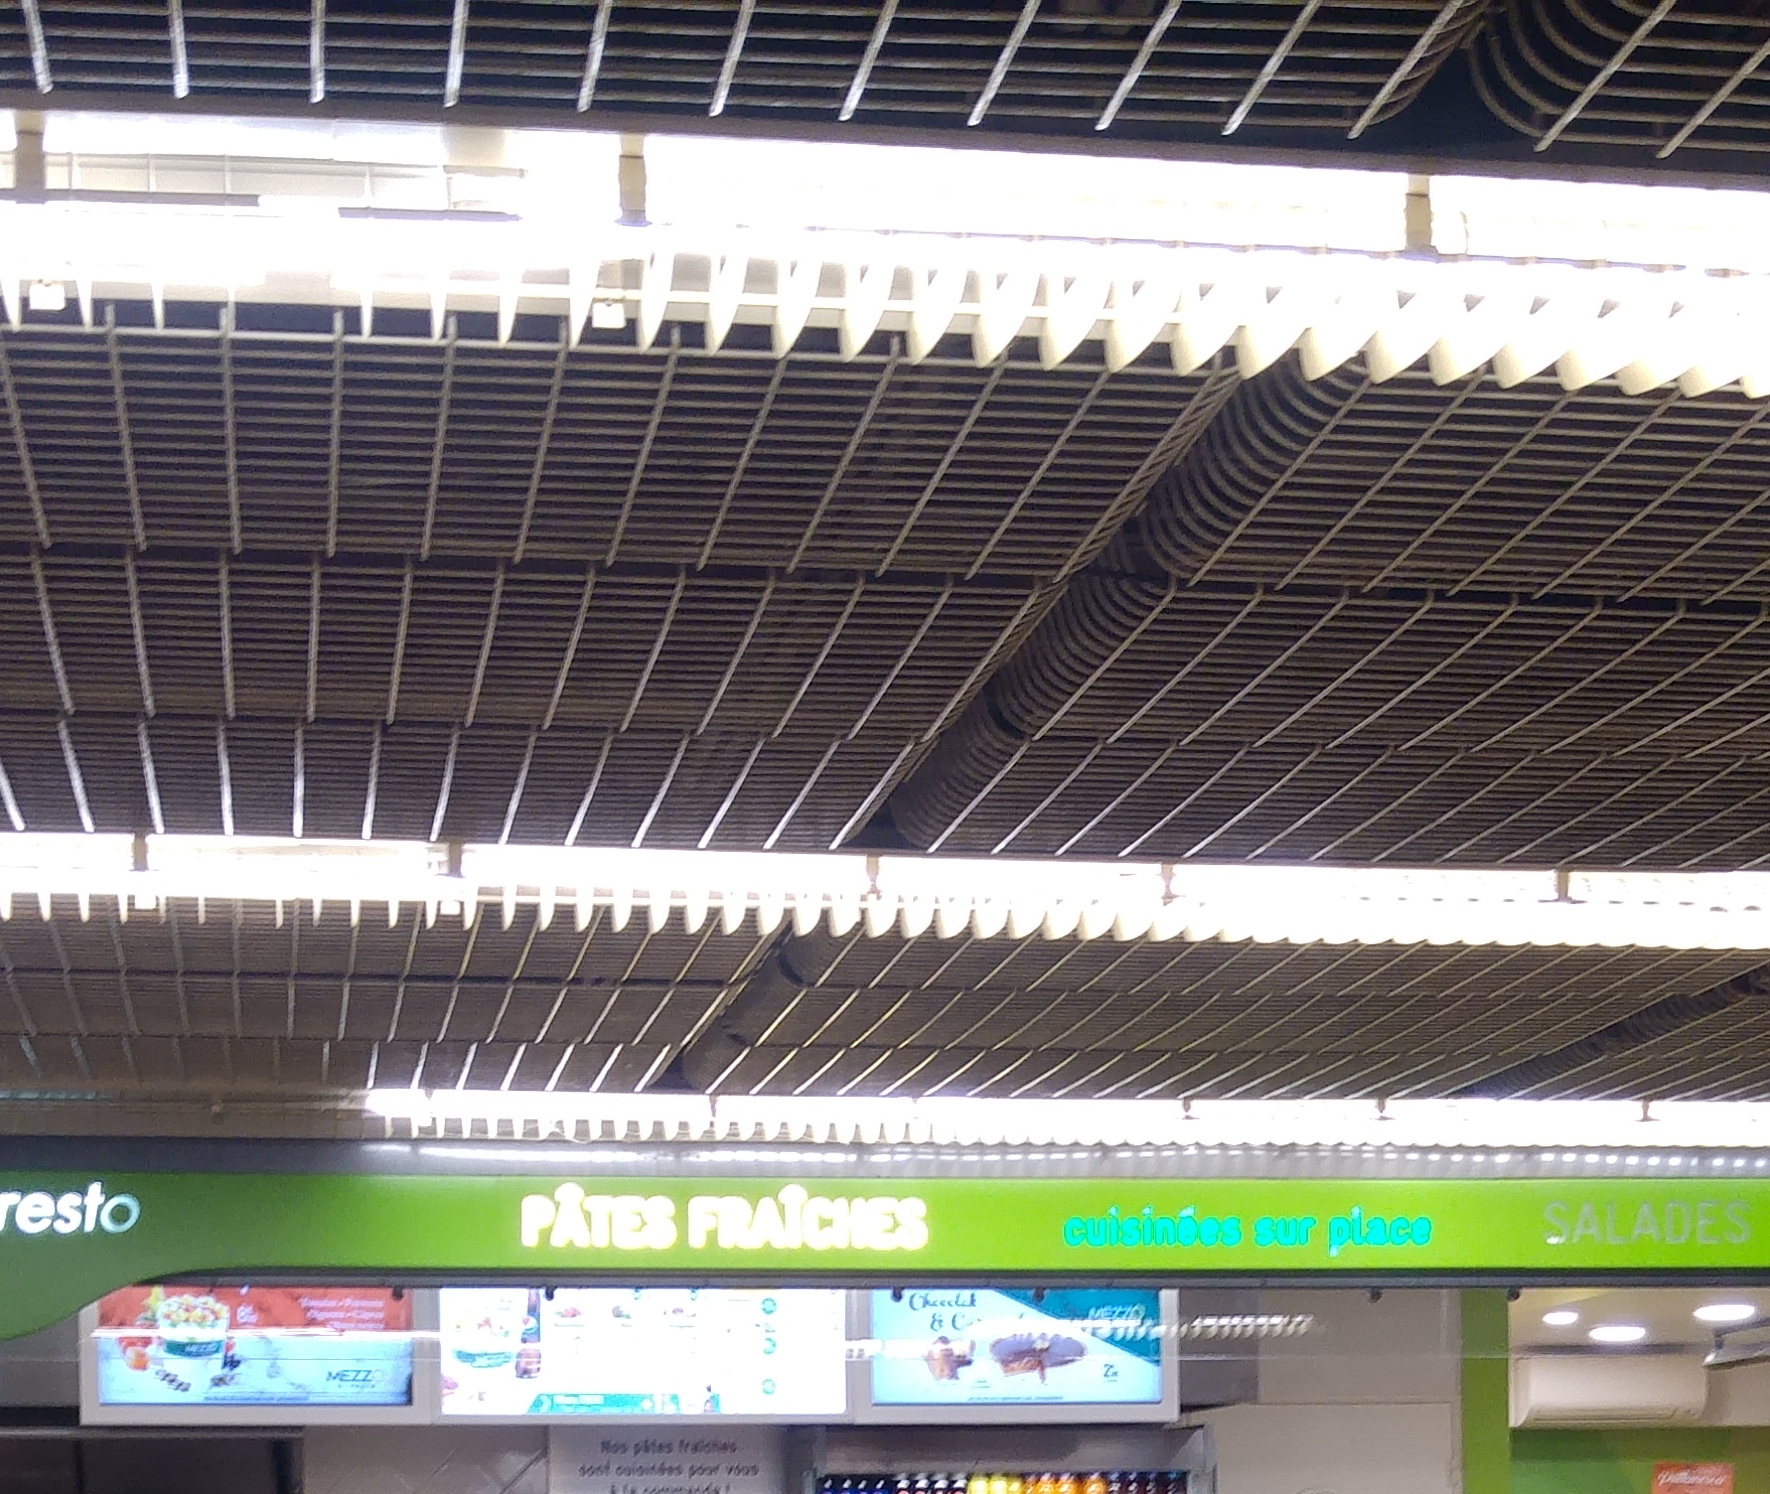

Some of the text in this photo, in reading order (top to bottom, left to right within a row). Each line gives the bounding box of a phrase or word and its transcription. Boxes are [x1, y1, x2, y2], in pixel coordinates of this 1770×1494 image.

[521, 1183, 927, 1251] PÂTES FRAÎCHES
[1065, 1204, 1432, 1256] cuisinées sur place
[1542, 1199, 1749, 1246] SALADES
[601, 1440, 628, 1454] Nos
